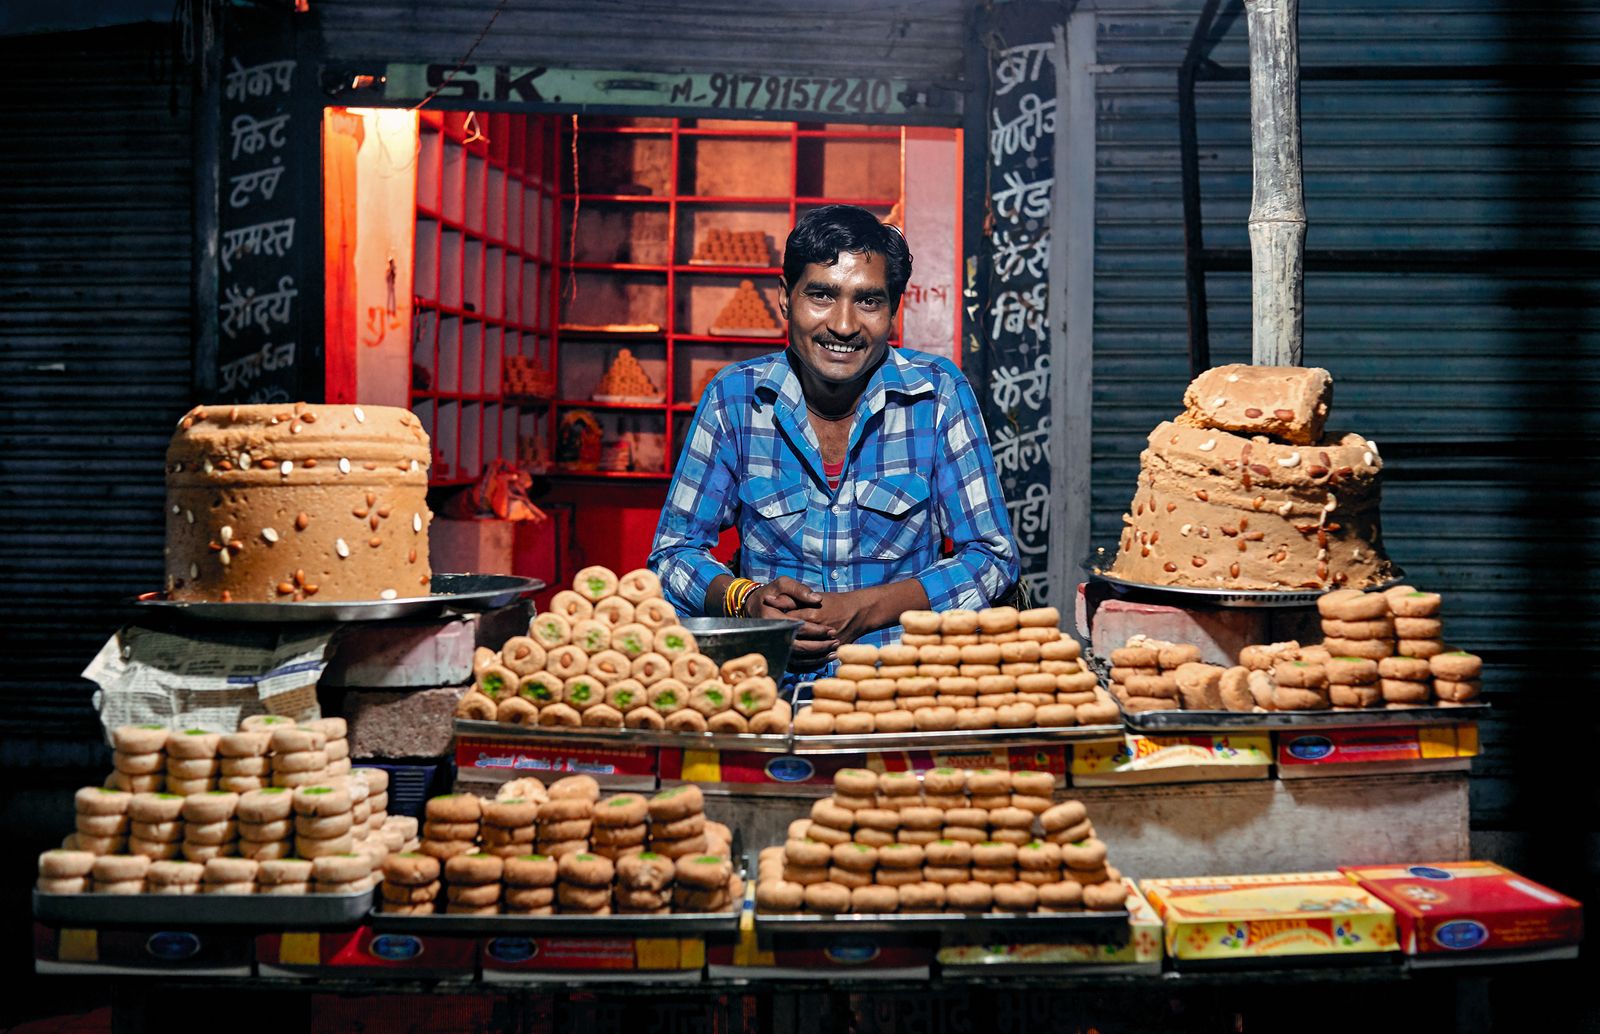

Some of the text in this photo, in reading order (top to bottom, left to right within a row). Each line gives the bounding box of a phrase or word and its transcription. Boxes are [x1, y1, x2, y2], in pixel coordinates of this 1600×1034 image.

[226, 56, 297, 102] मेकप
[425, 64, 562, 103] S.K.
[231, 113, 290, 161] किट
[221, 217, 296, 273] समस्त
